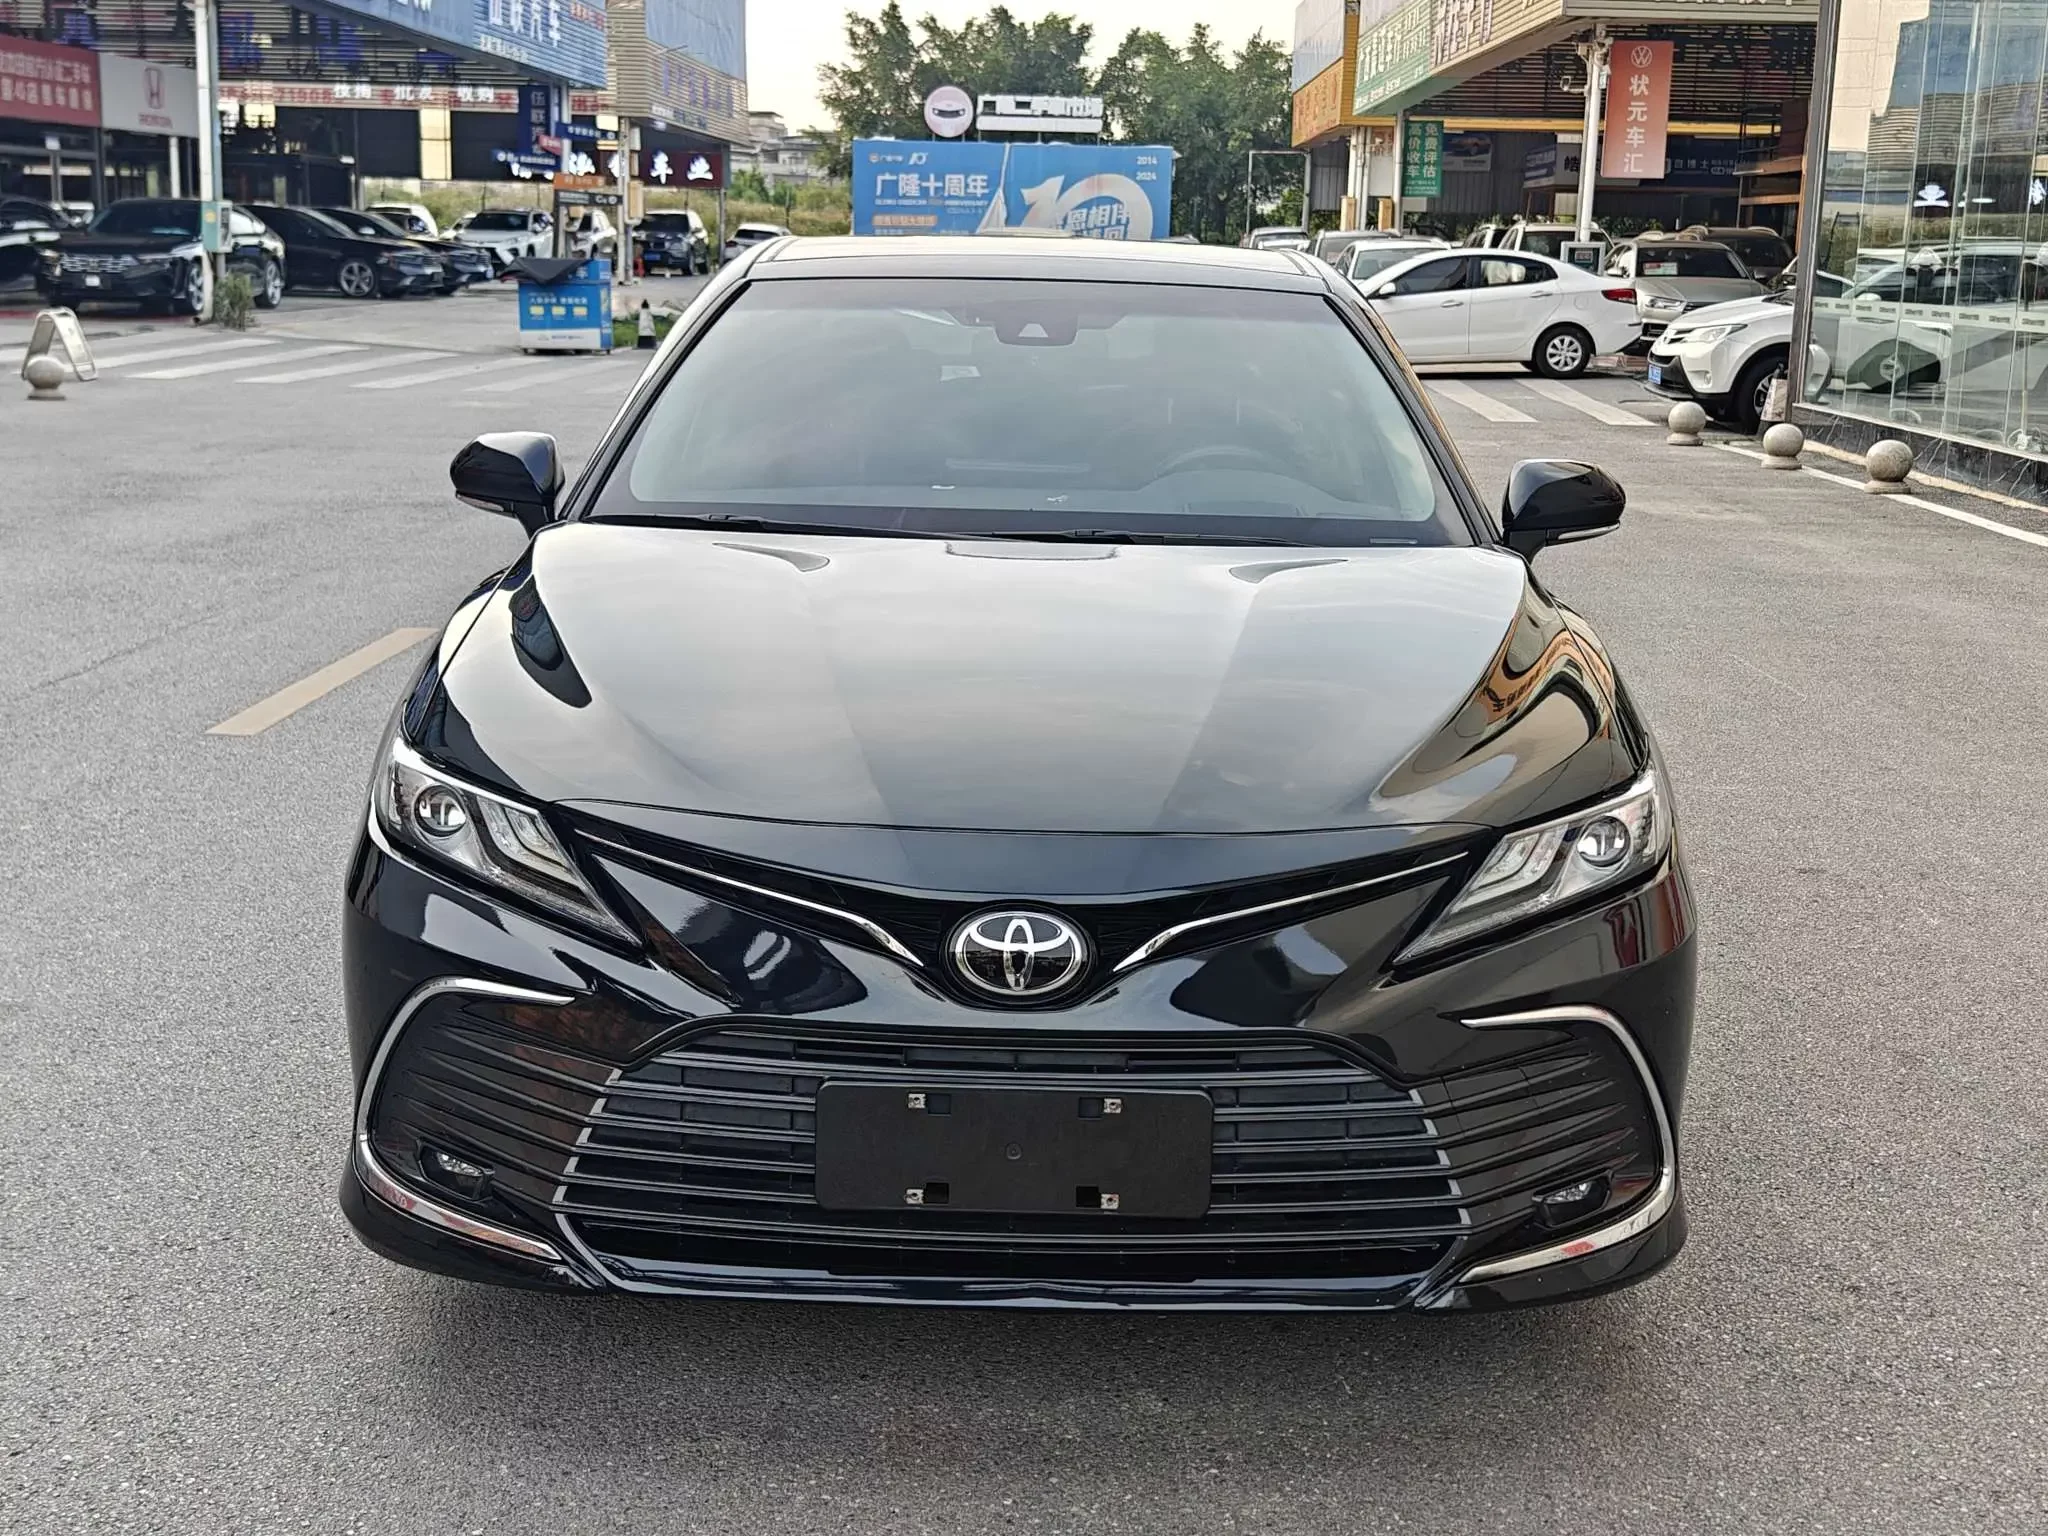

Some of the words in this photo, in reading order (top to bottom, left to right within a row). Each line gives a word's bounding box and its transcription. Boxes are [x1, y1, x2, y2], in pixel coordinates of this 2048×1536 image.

[1623, 74, 1650, 173] 状元车汇
[1136, 156, 1157, 165] 2014
[1406, 123, 1421, 178] 高价收车
[1423, 123, 1440, 178] 免费评估
[875, 173, 990, 197] 广隆十周年
[1136, 171, 1157, 181] 2024
